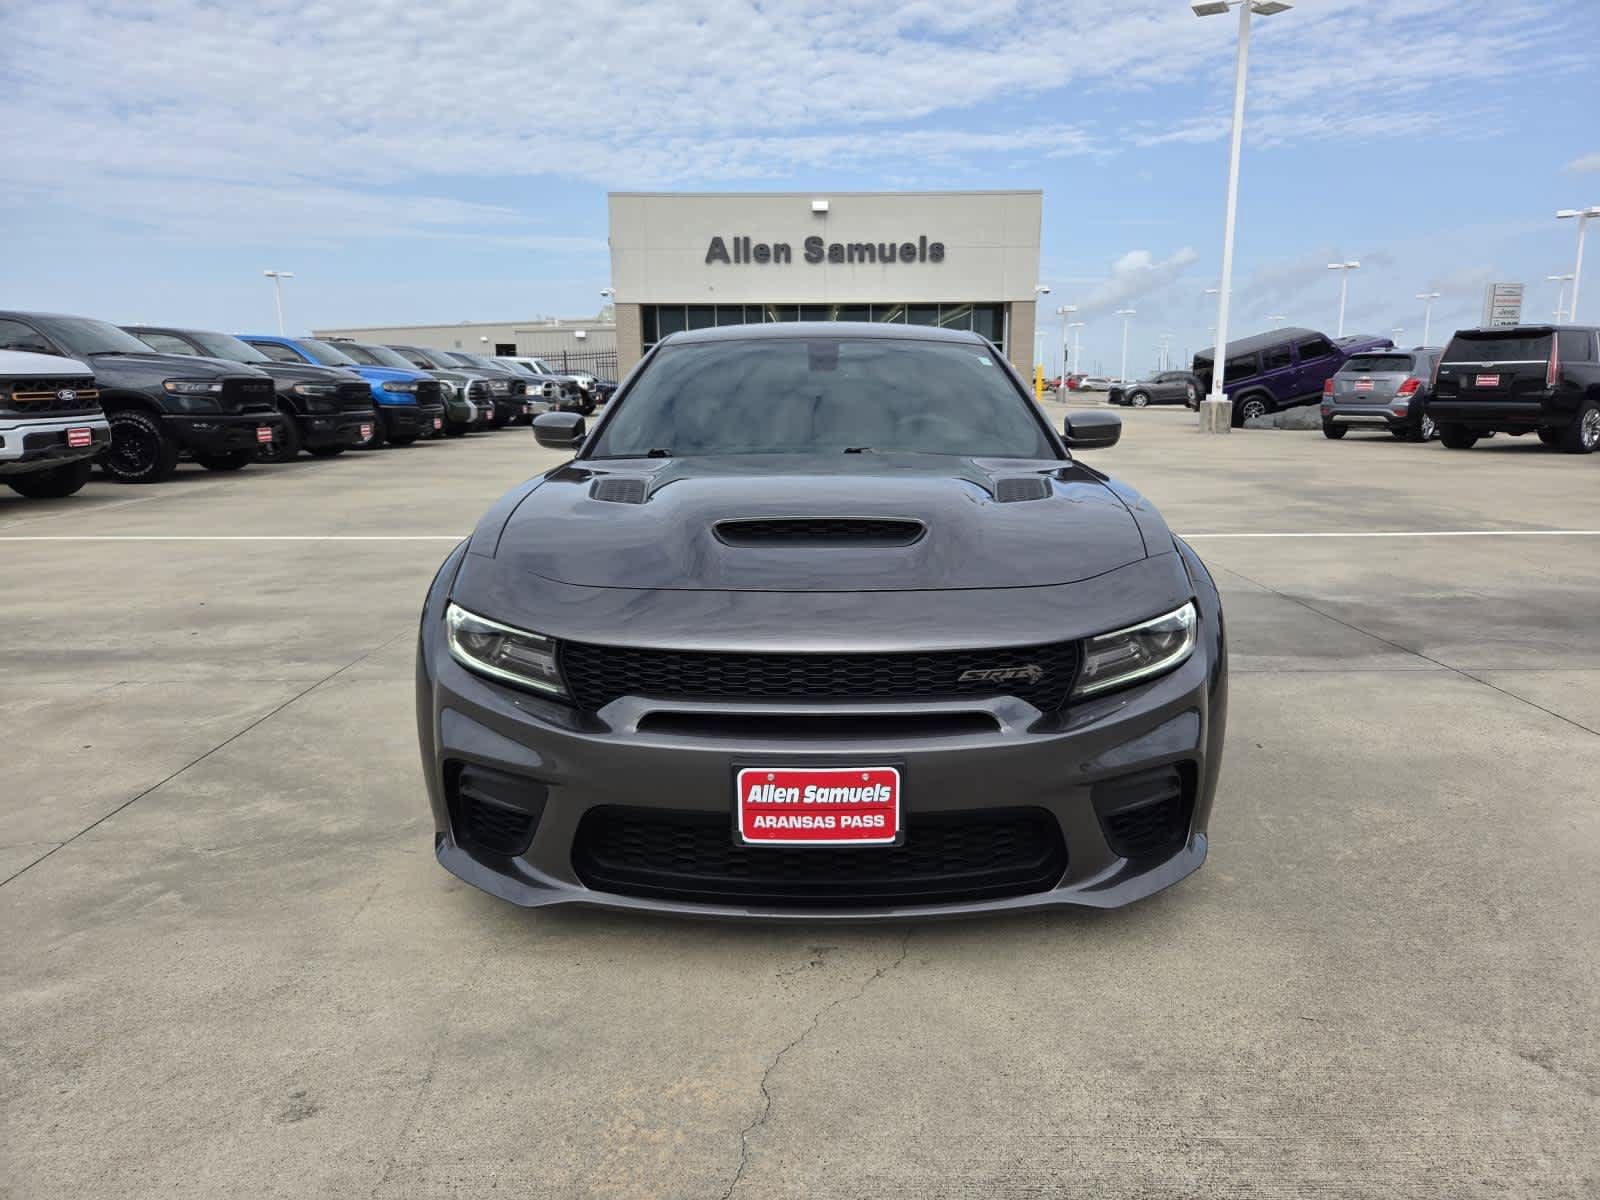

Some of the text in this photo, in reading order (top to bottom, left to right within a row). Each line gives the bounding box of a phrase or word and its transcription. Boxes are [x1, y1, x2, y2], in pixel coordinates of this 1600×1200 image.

[705, 235, 945, 264] Allen Samuels
[747, 783, 892, 804] Allen Samuels
[753, 815, 885, 829] ARANSAS PASS
